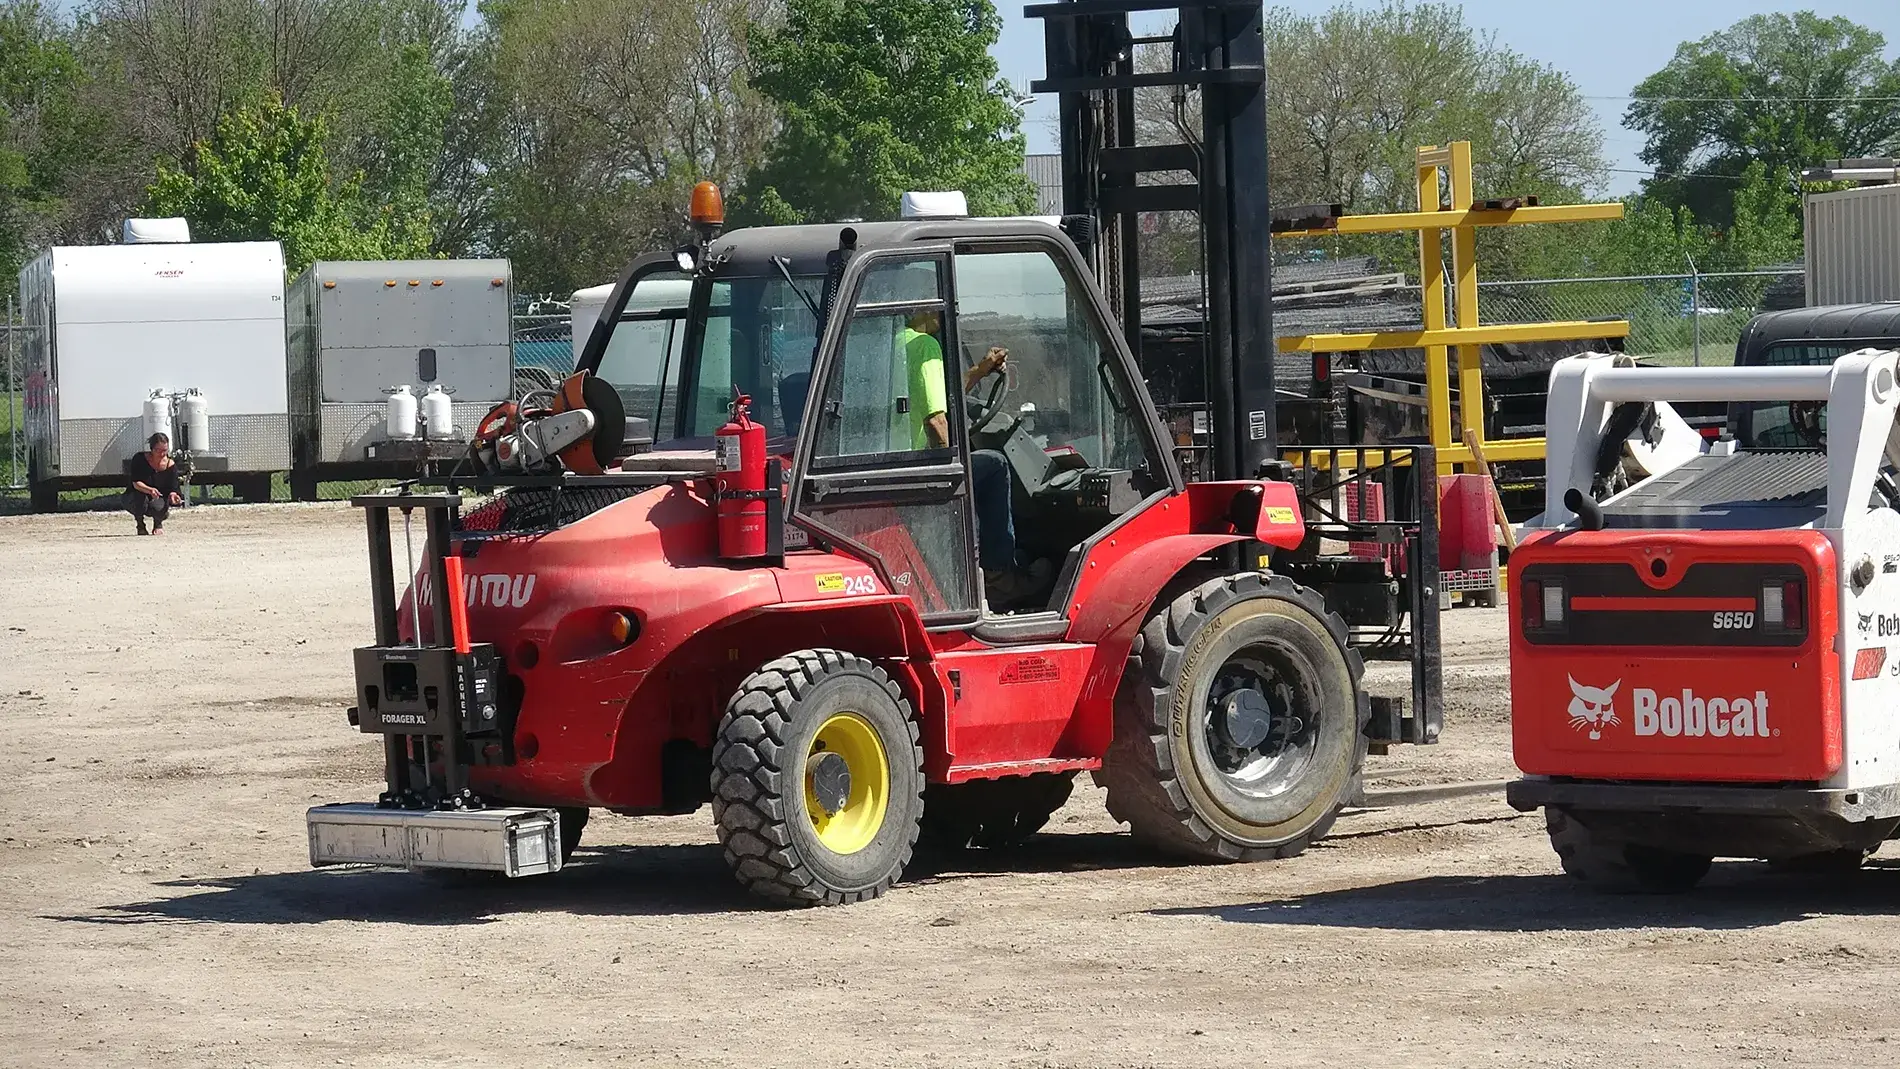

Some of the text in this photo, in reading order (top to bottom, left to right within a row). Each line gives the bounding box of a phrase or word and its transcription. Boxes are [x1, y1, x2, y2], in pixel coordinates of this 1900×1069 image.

[419, 573, 537, 608] MITOU
[844, 574, 877, 596] 243
[1712, 611, 1755, 630] S650
[457, 664, 468, 718] MAGNET
[381, 713, 427, 725] FORAGER XL
[1633, 687, 1770, 738] Bobcat
